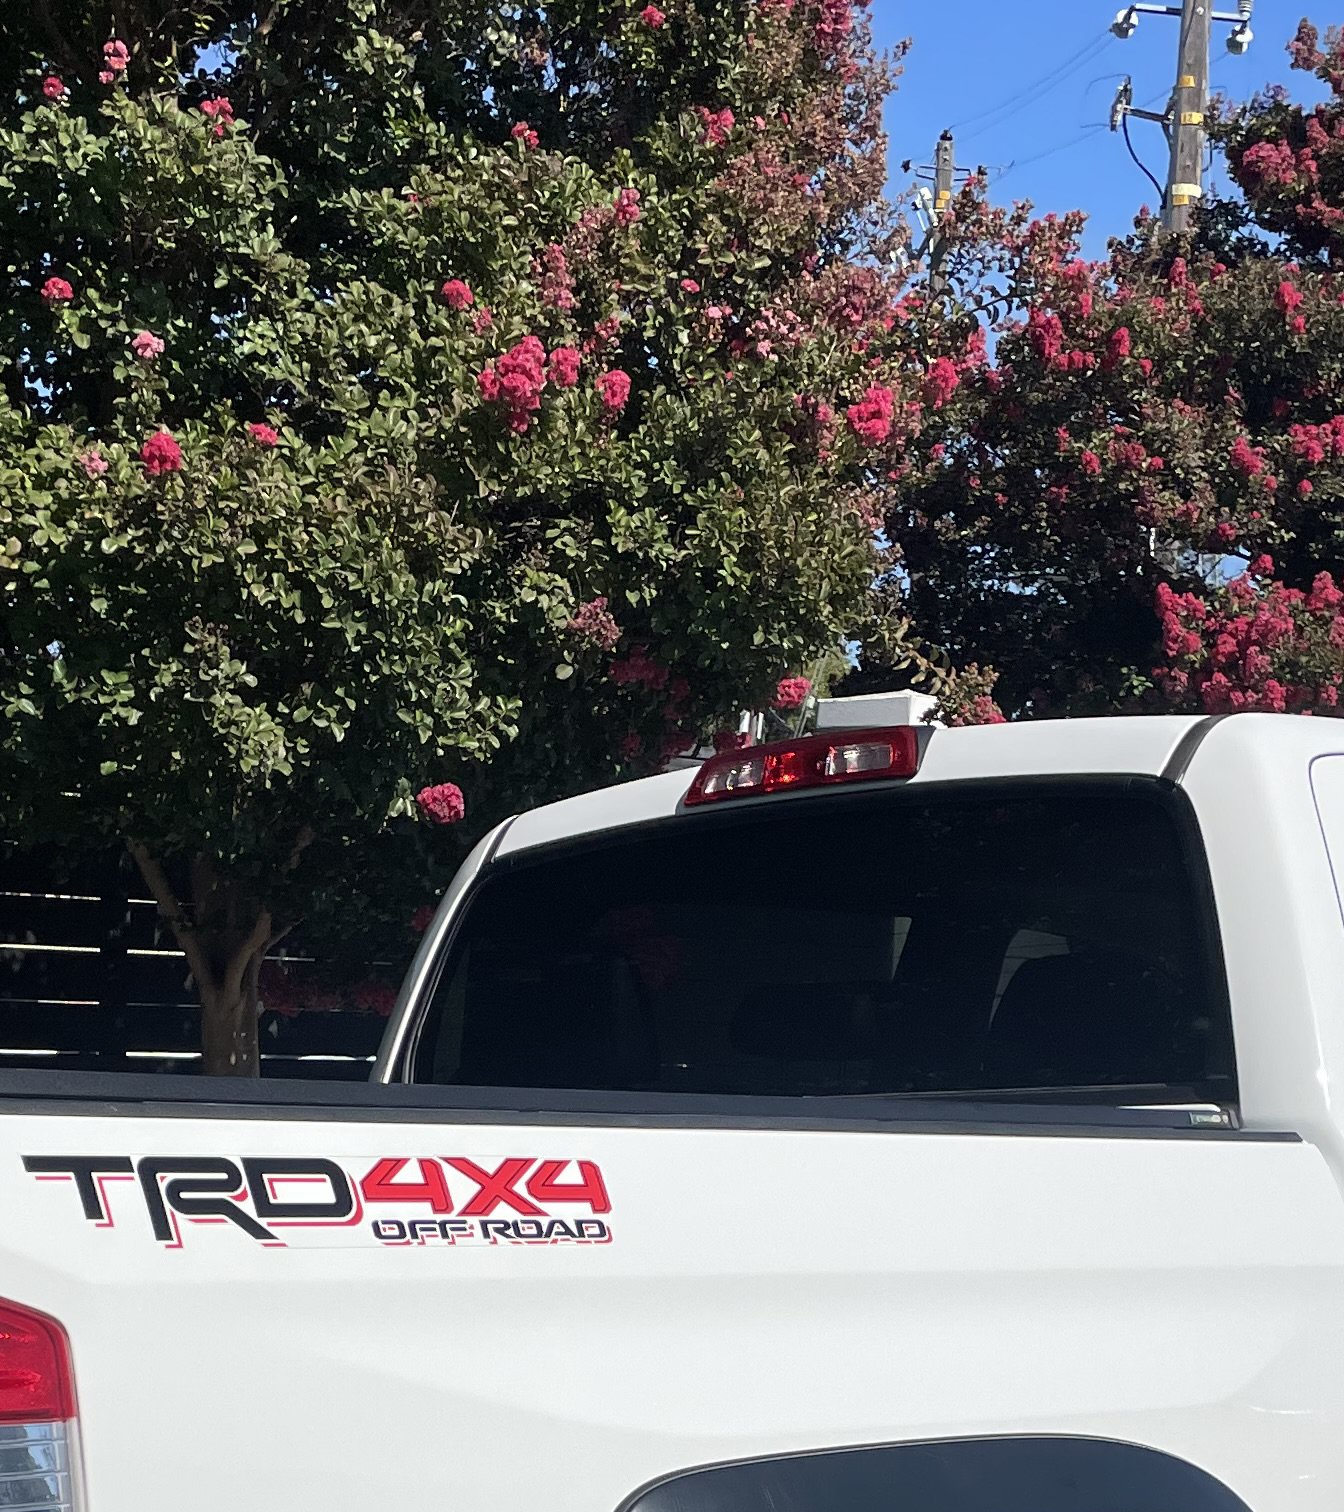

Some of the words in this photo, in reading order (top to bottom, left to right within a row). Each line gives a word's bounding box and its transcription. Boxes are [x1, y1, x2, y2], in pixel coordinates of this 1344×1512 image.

[19, 1154, 363, 1249] TRD
[360, 1156, 612, 1217] 4X4
[370, 1218, 475, 1246] OFF
[478, 1218, 613, 1245] ROAD
